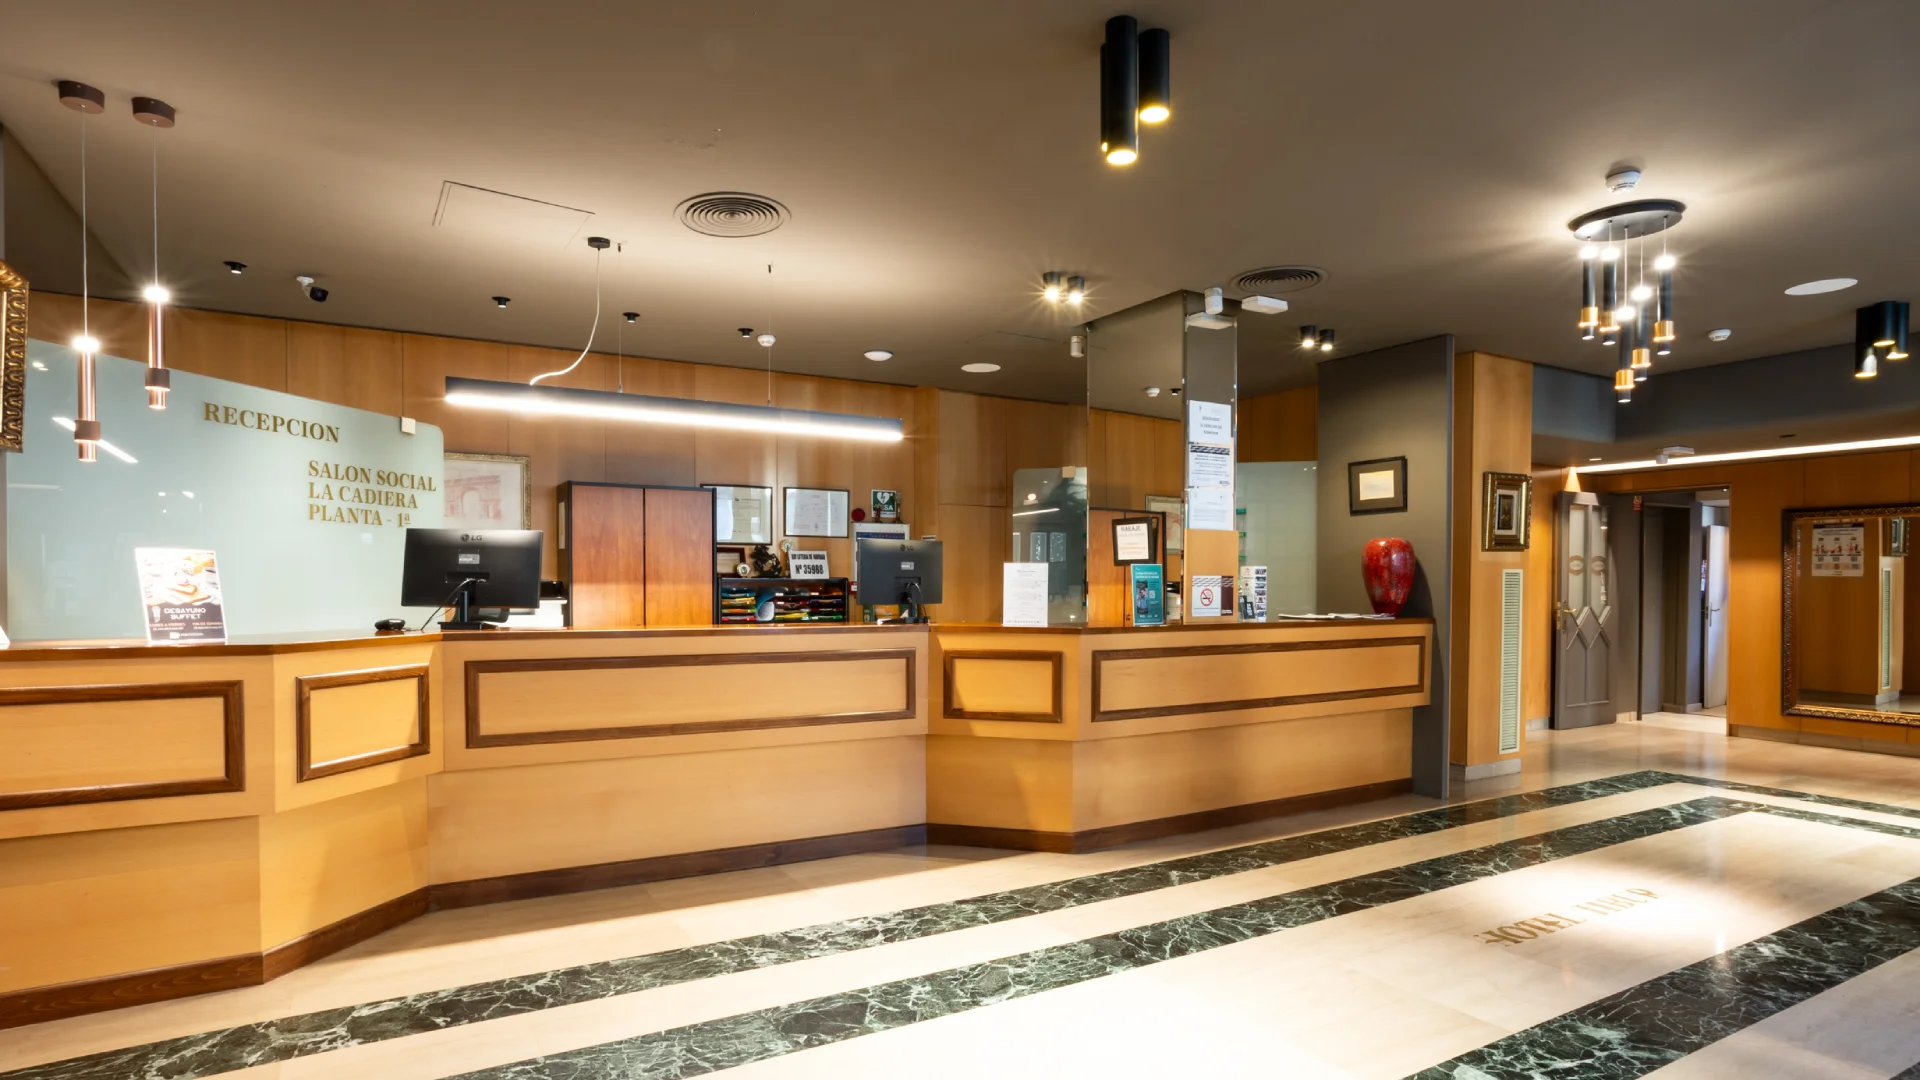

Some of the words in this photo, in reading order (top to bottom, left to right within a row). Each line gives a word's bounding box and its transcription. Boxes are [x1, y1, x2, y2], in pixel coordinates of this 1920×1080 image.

[203, 402, 340, 443] RECEPCION
[308, 460, 372, 484] SALON
[376, 469, 437, 492] SOCIAL
[308, 481, 334, 501] LA
[339, 485, 418, 509] CADIERA
[308, 503, 383, 526] PLANTA
[1473, 912, 1587, 948] HOTEL
